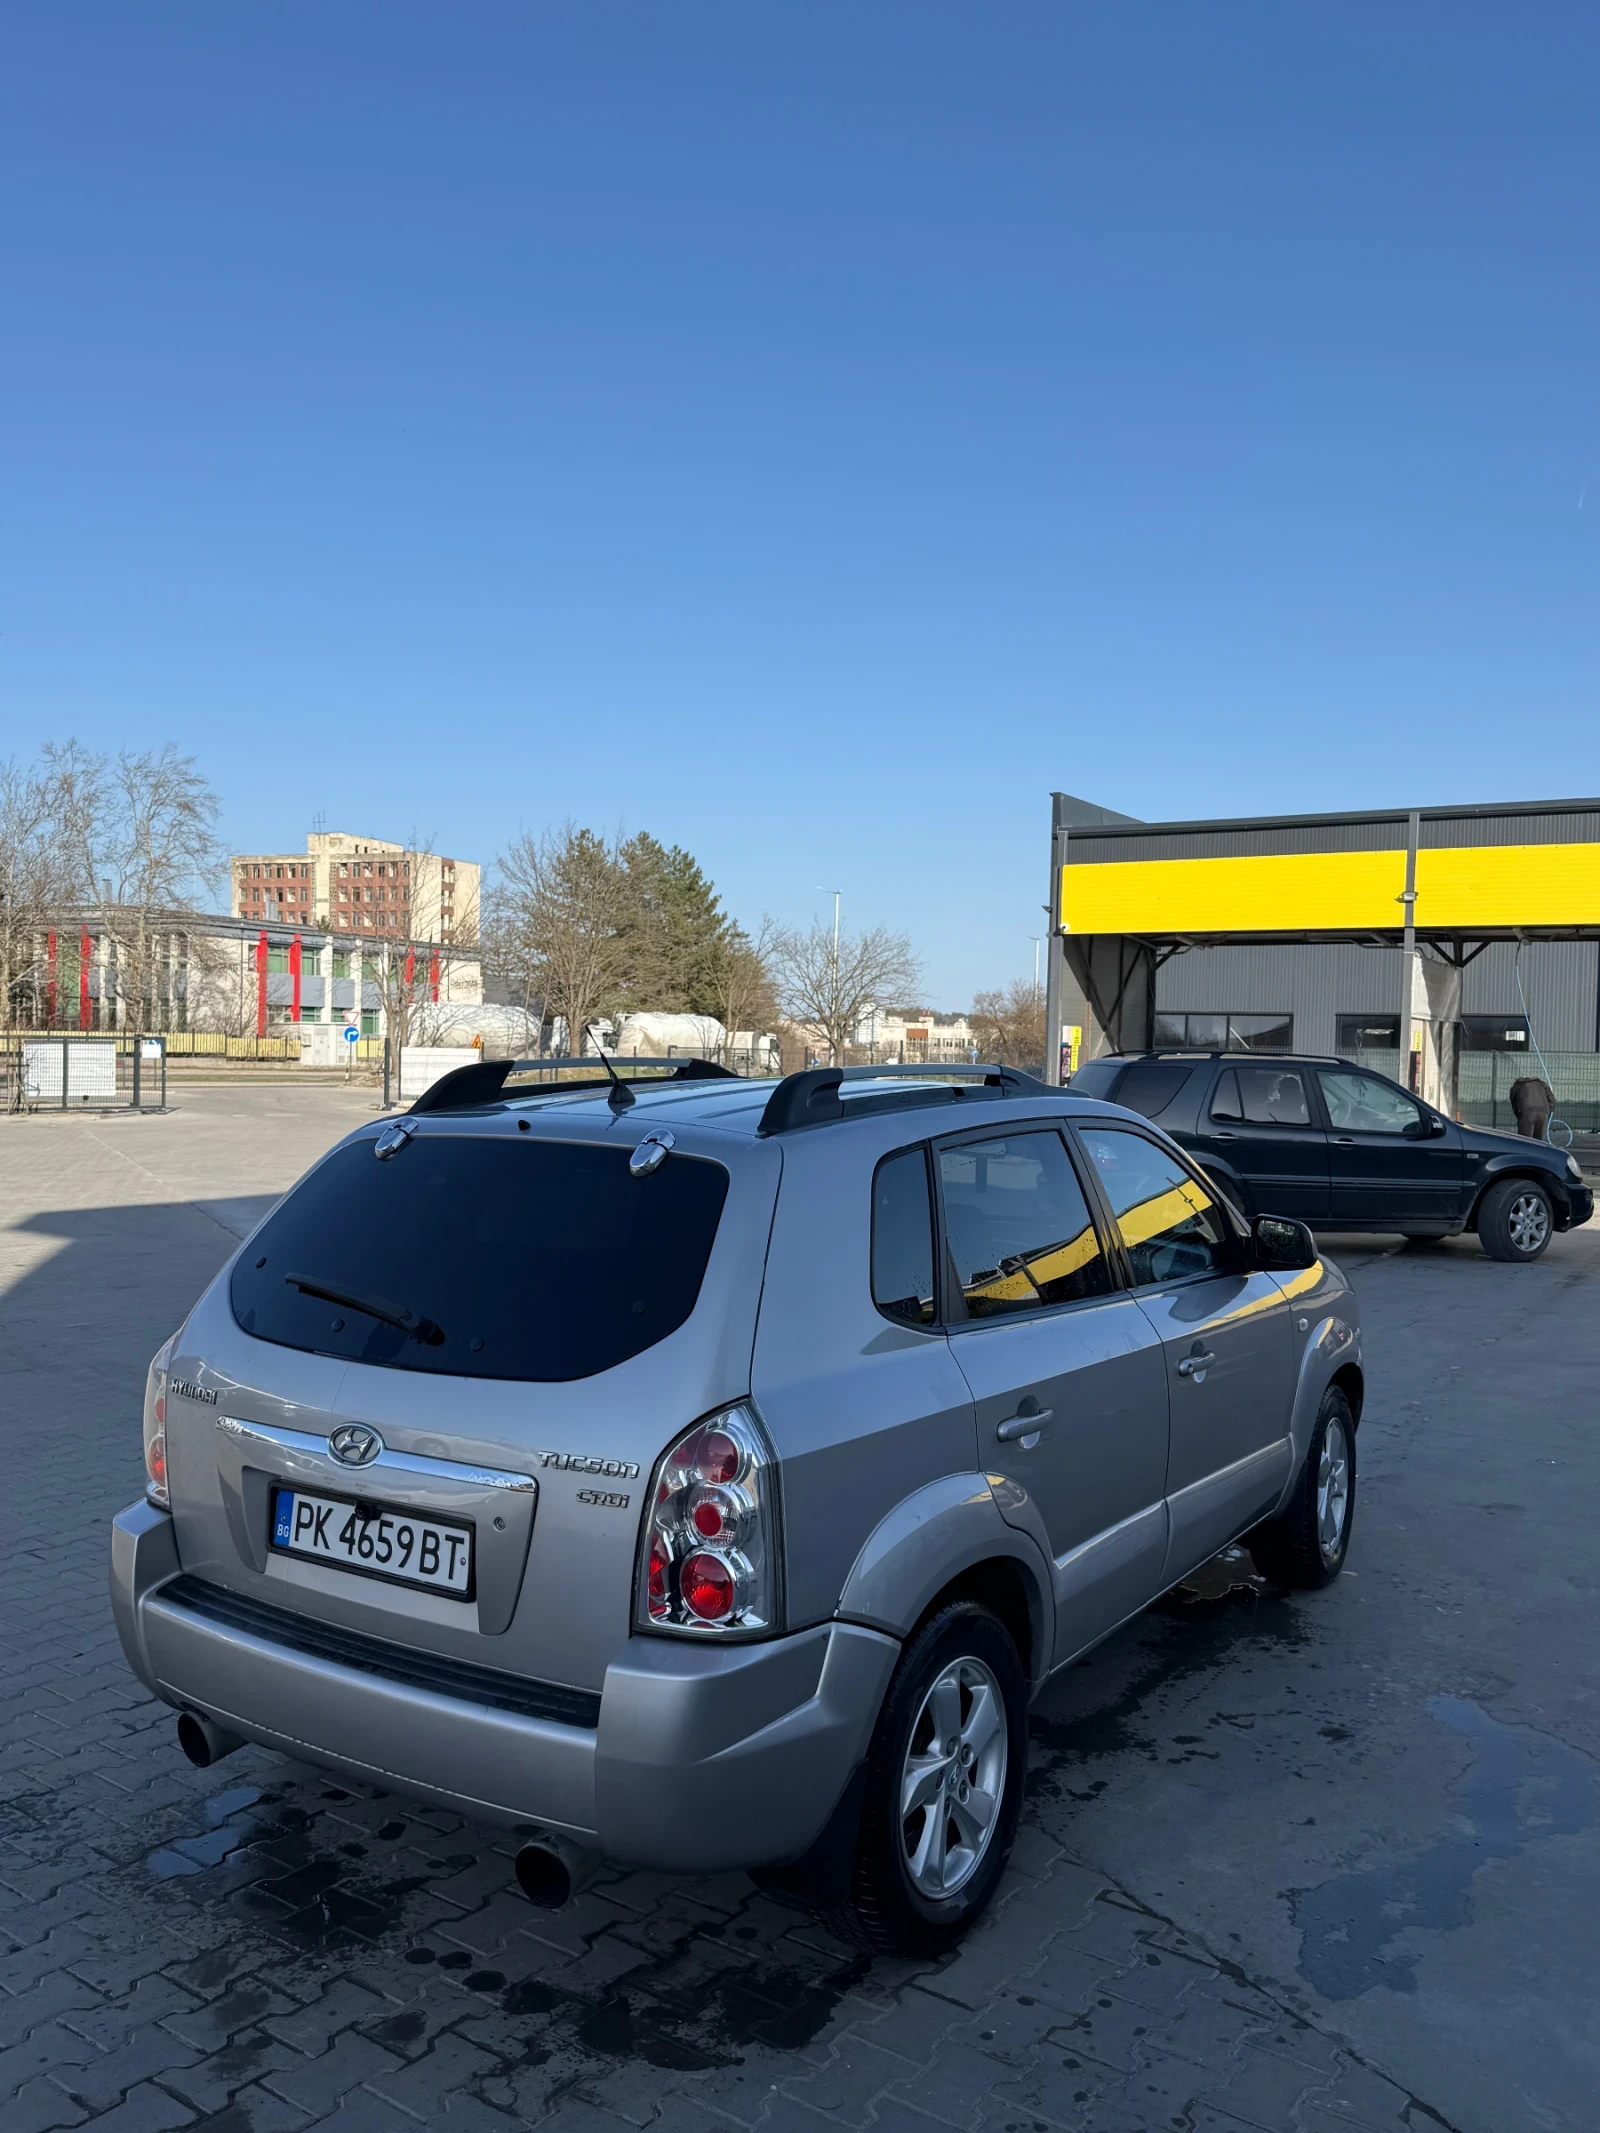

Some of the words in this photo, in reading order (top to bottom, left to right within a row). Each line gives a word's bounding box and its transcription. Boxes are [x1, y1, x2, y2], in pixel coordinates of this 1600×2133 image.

[171, 1378, 218, 1406] HYUNDAI
[537, 1450, 640, 1479] TUCSON
[576, 1488, 630, 1508] CRDi
[276, 1523, 289, 1538] BG
